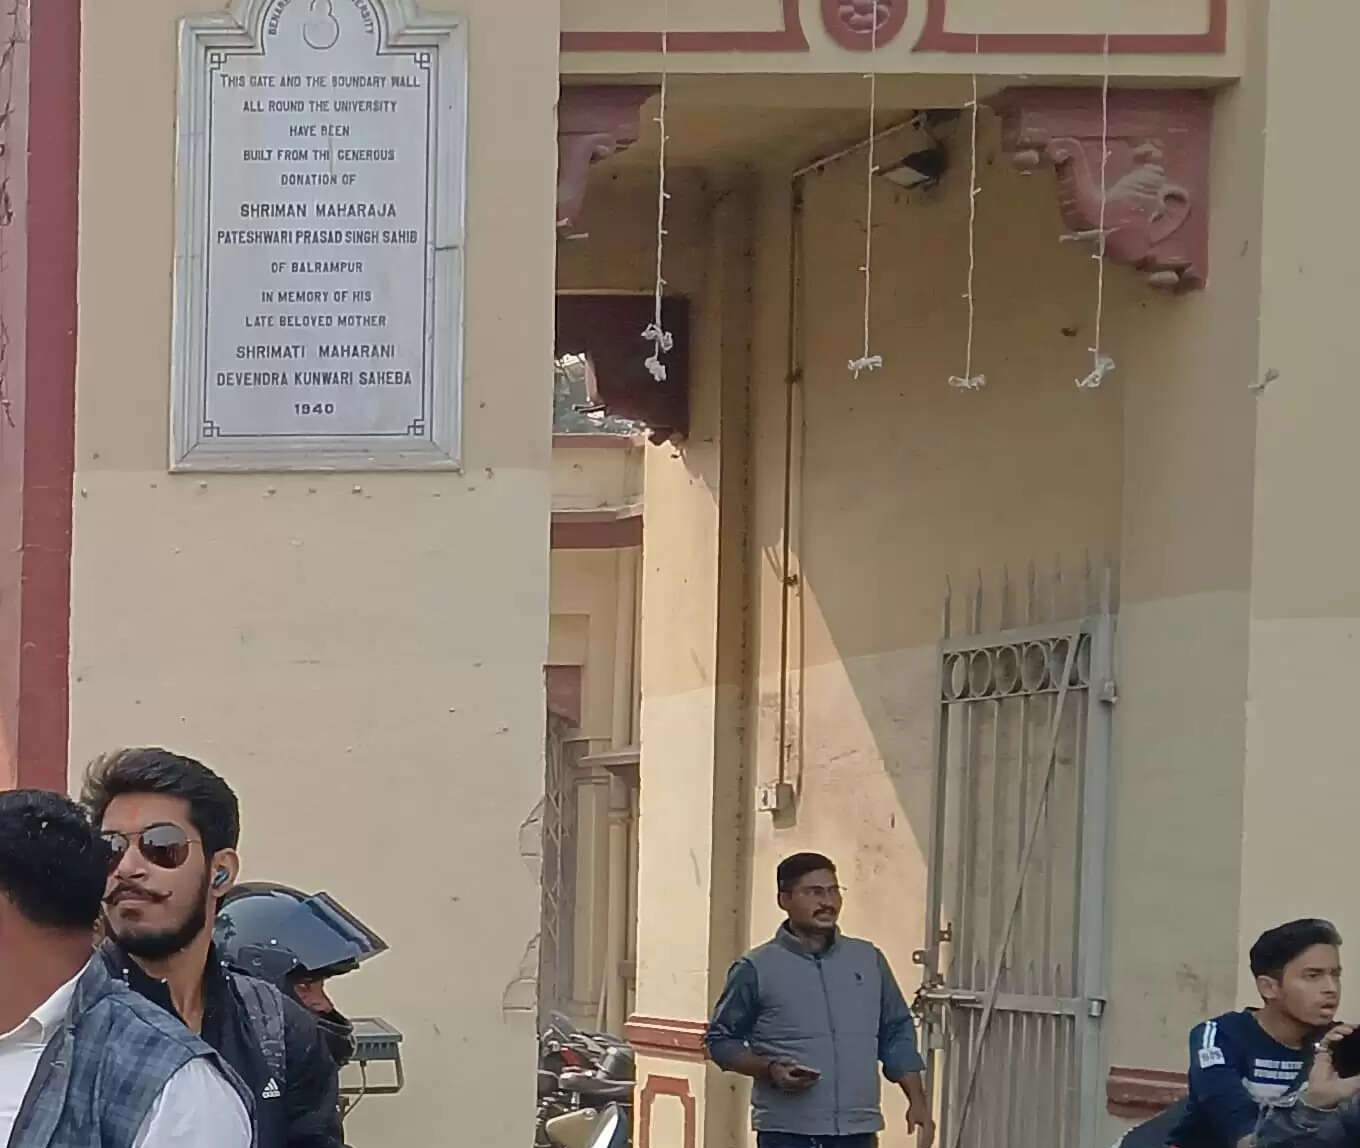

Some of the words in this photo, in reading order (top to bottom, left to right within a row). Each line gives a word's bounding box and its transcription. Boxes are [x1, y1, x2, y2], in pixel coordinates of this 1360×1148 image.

[220, 74, 246, 88] THIS
[249, 75, 276, 87] GATE
[279, 75, 301, 87] AND
[306, 75, 327, 87] THE
[331, 75, 386, 88] BOUNDARY
[391, 75, 421, 88] WALL
[242, 100, 265, 112] ALL
[268, 100, 304, 112] ROUND
[308, 100, 330, 112] THE
[333, 99, 397, 112] UNIVERSITY
[289, 125, 316, 137] HAVE
[321, 124, 350, 137] BEEN
[243, 149, 273, 161] BUILT
[277, 149, 308, 161] FROM
[337, 149, 395, 161] GENEROUS
[280, 173, 338, 186] DONATION
[341, 173, 357, 186] OF
[240, 203, 307, 218] SHRIMAN
[315, 203, 397, 218] MAHARAJA
[217, 230, 293, 244] PATESHWARI
[295, 230, 343, 244] PRASAD
[345, 230, 379, 244] SINGH
[382, 230, 418, 244] SAHIB
[271, 261, 286, 274] OF
[291, 261, 363, 274] BALRAMPUR
[261, 291, 274, 303] IN
[278, 291, 329, 303] MEMORY
[333, 290, 349, 303] OF
[352, 291, 372, 302] HIS
[245, 315, 275, 328] LATE
[279, 315, 333, 327] BELOVED
[337, 315, 387, 327] MOTHER
[236, 345, 305, 360] SHRIMATI
[319, 344, 395, 359] MAHARANI
[216, 371, 289, 387] DEVENDRA
[294, 371, 354, 386] KUNWARI
[358, 371, 412, 386] SAHEBA
[294, 403, 335, 416] 1940
